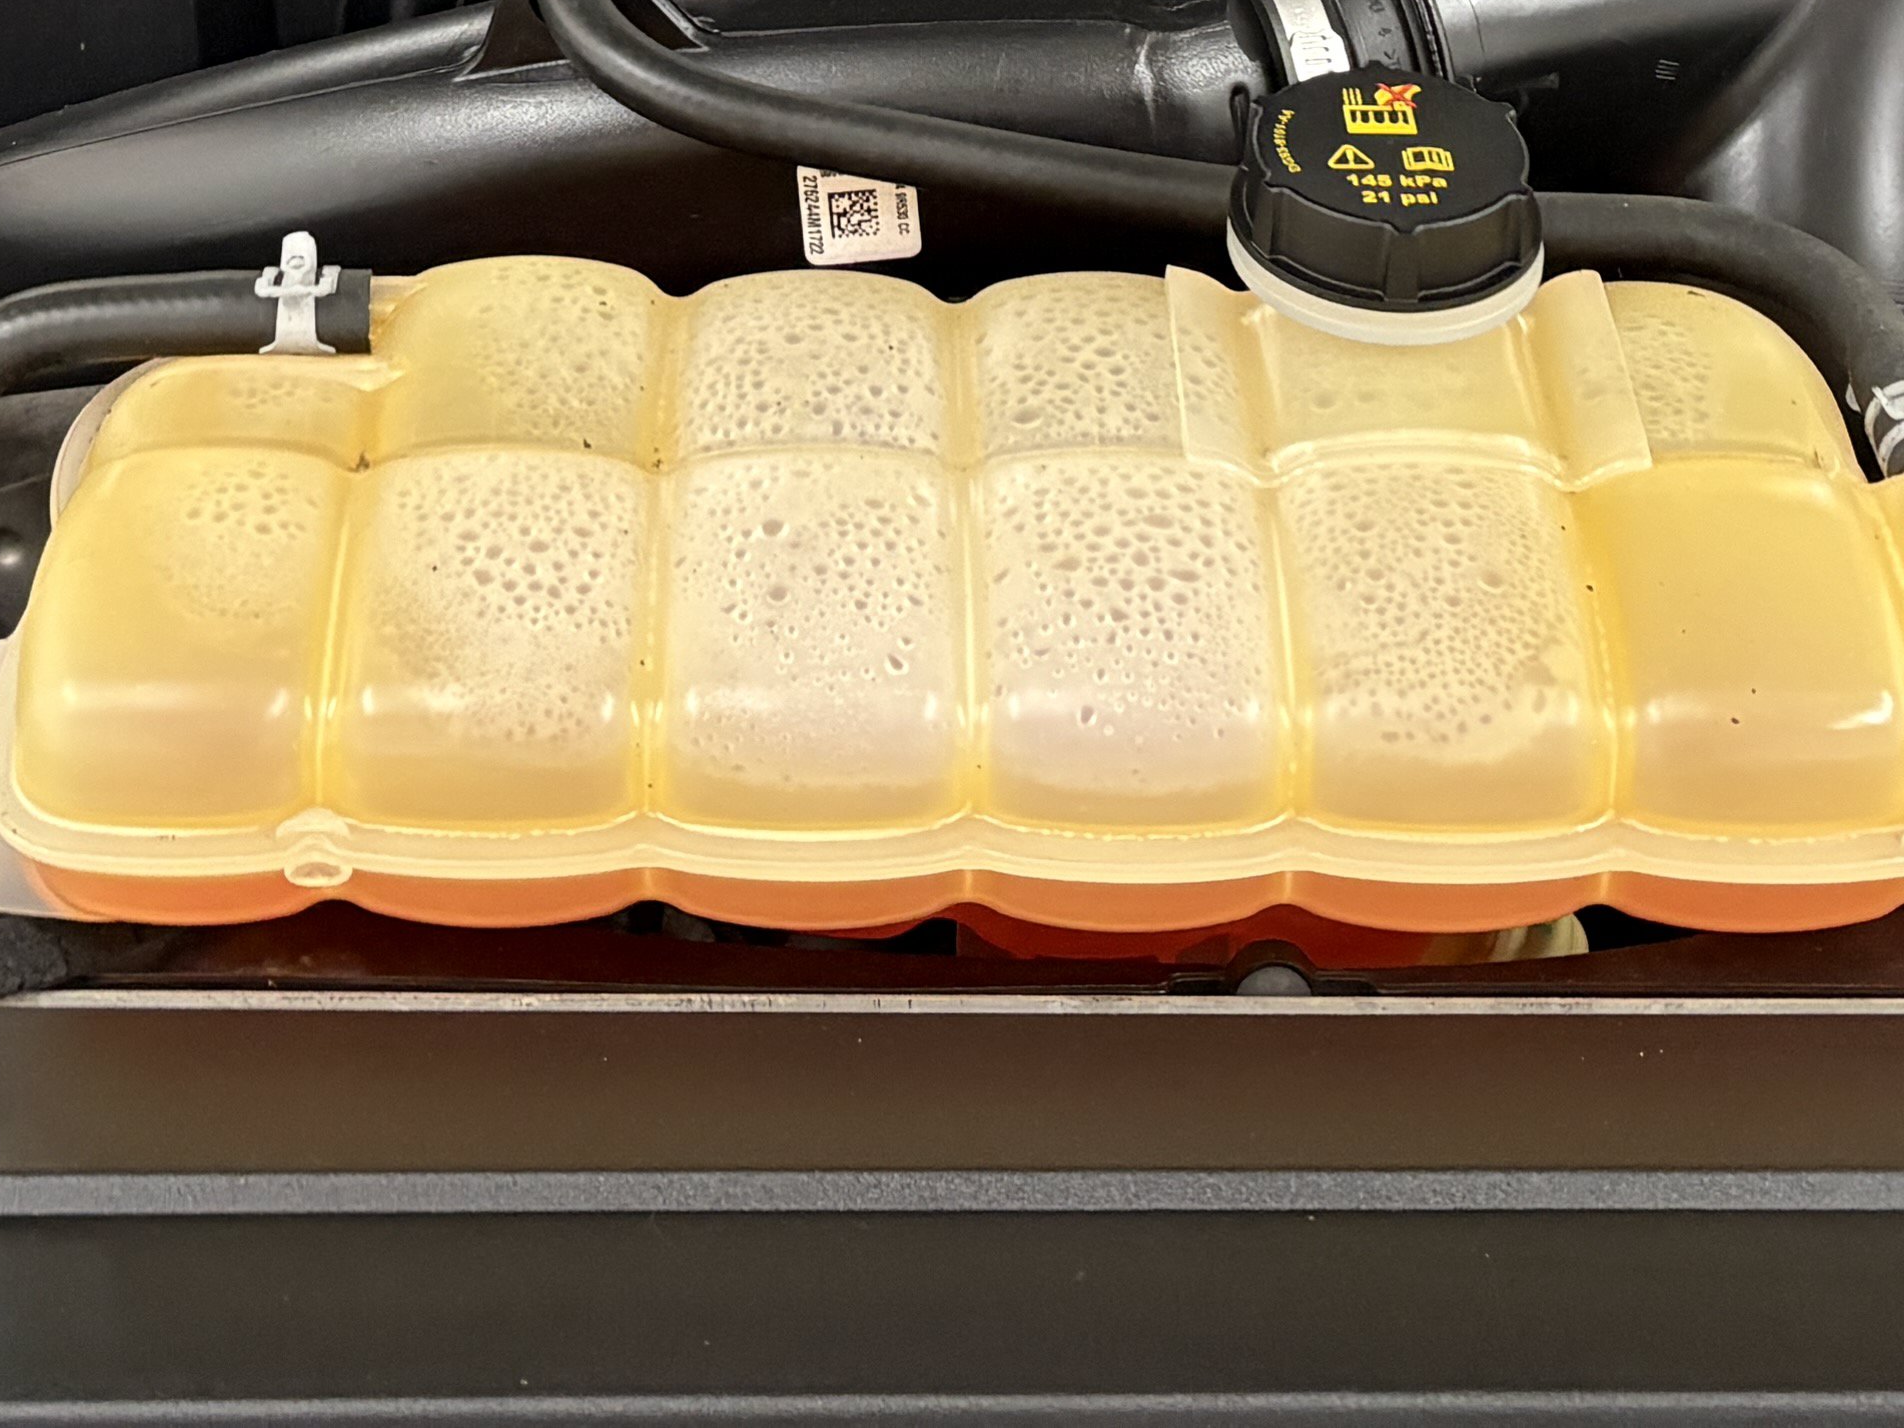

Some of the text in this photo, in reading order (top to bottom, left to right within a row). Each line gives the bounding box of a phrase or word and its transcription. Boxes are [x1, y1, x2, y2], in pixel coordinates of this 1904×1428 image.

[1346, 173, 1448, 188] 145 kPa
[1361, 190, 1438, 206] 21 psi
